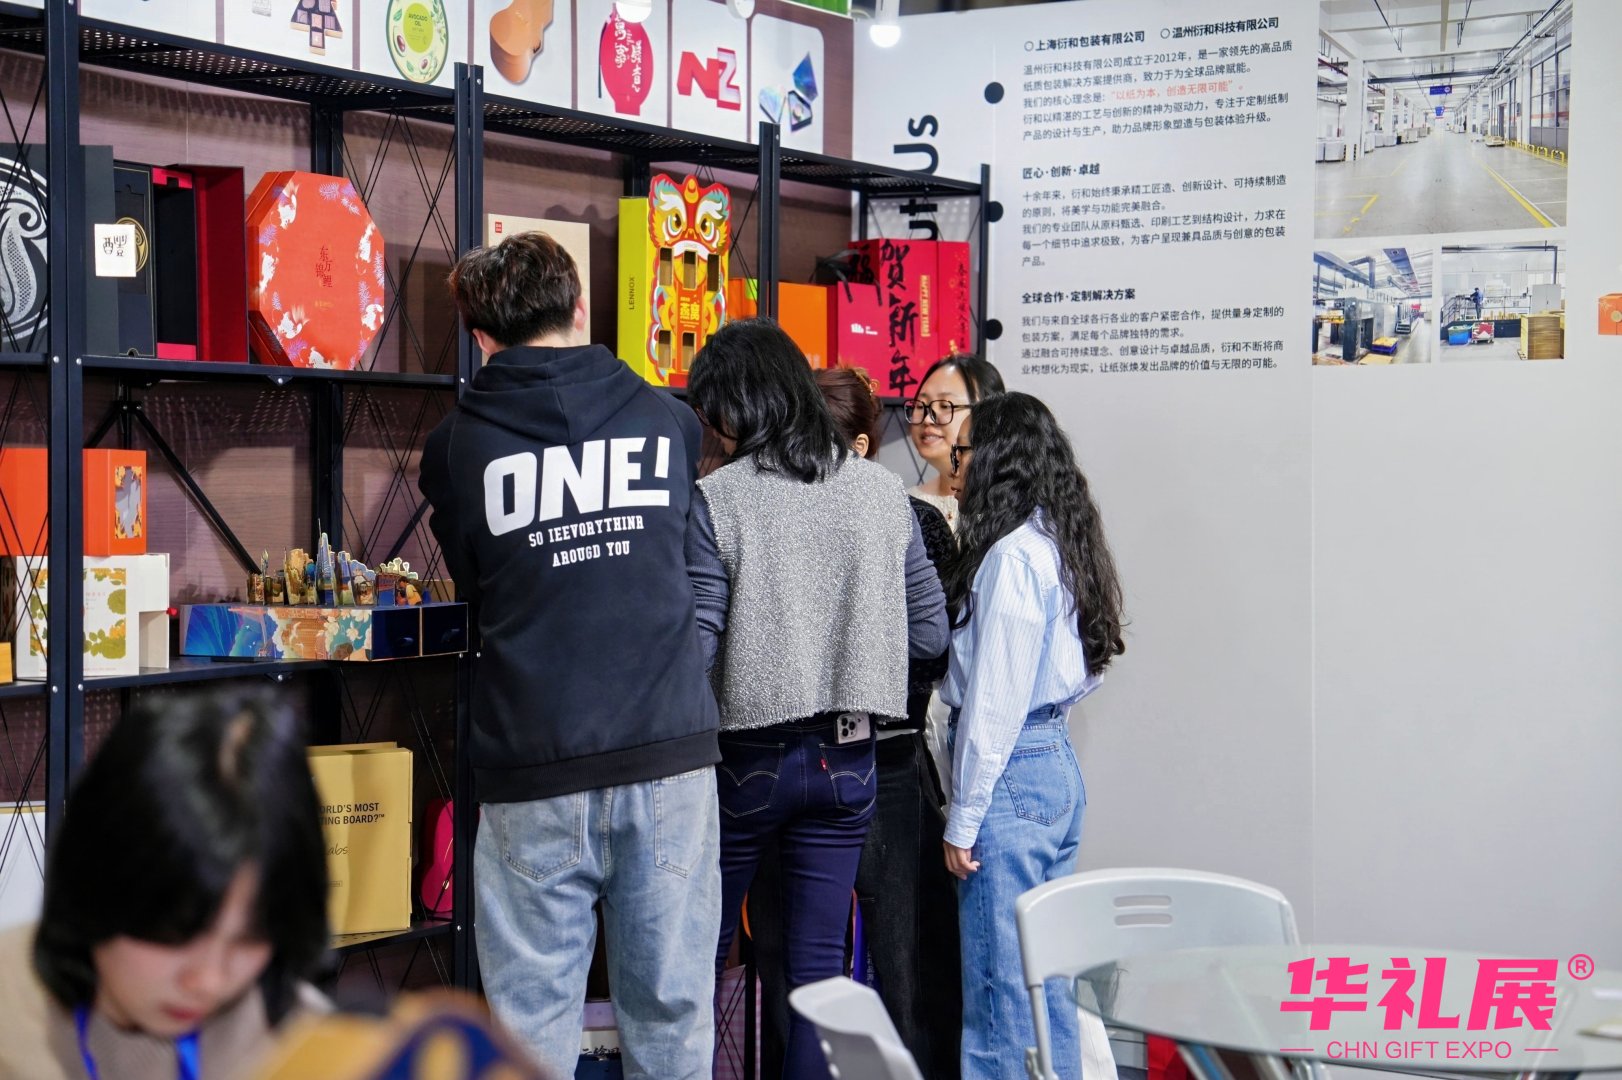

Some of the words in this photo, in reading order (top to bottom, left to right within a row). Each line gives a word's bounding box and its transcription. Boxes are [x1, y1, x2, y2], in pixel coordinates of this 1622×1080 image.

[1172, 16, 1279, 39] 温州衍和科技有限公司
[1035, 30, 1145, 52] 上海衍和包装有限公司
[528, 529, 544, 548] SO
[606, 540, 630, 557] YOU
[319, 804, 352, 814] ORLD'S
[354, 802, 380, 813] MOST
